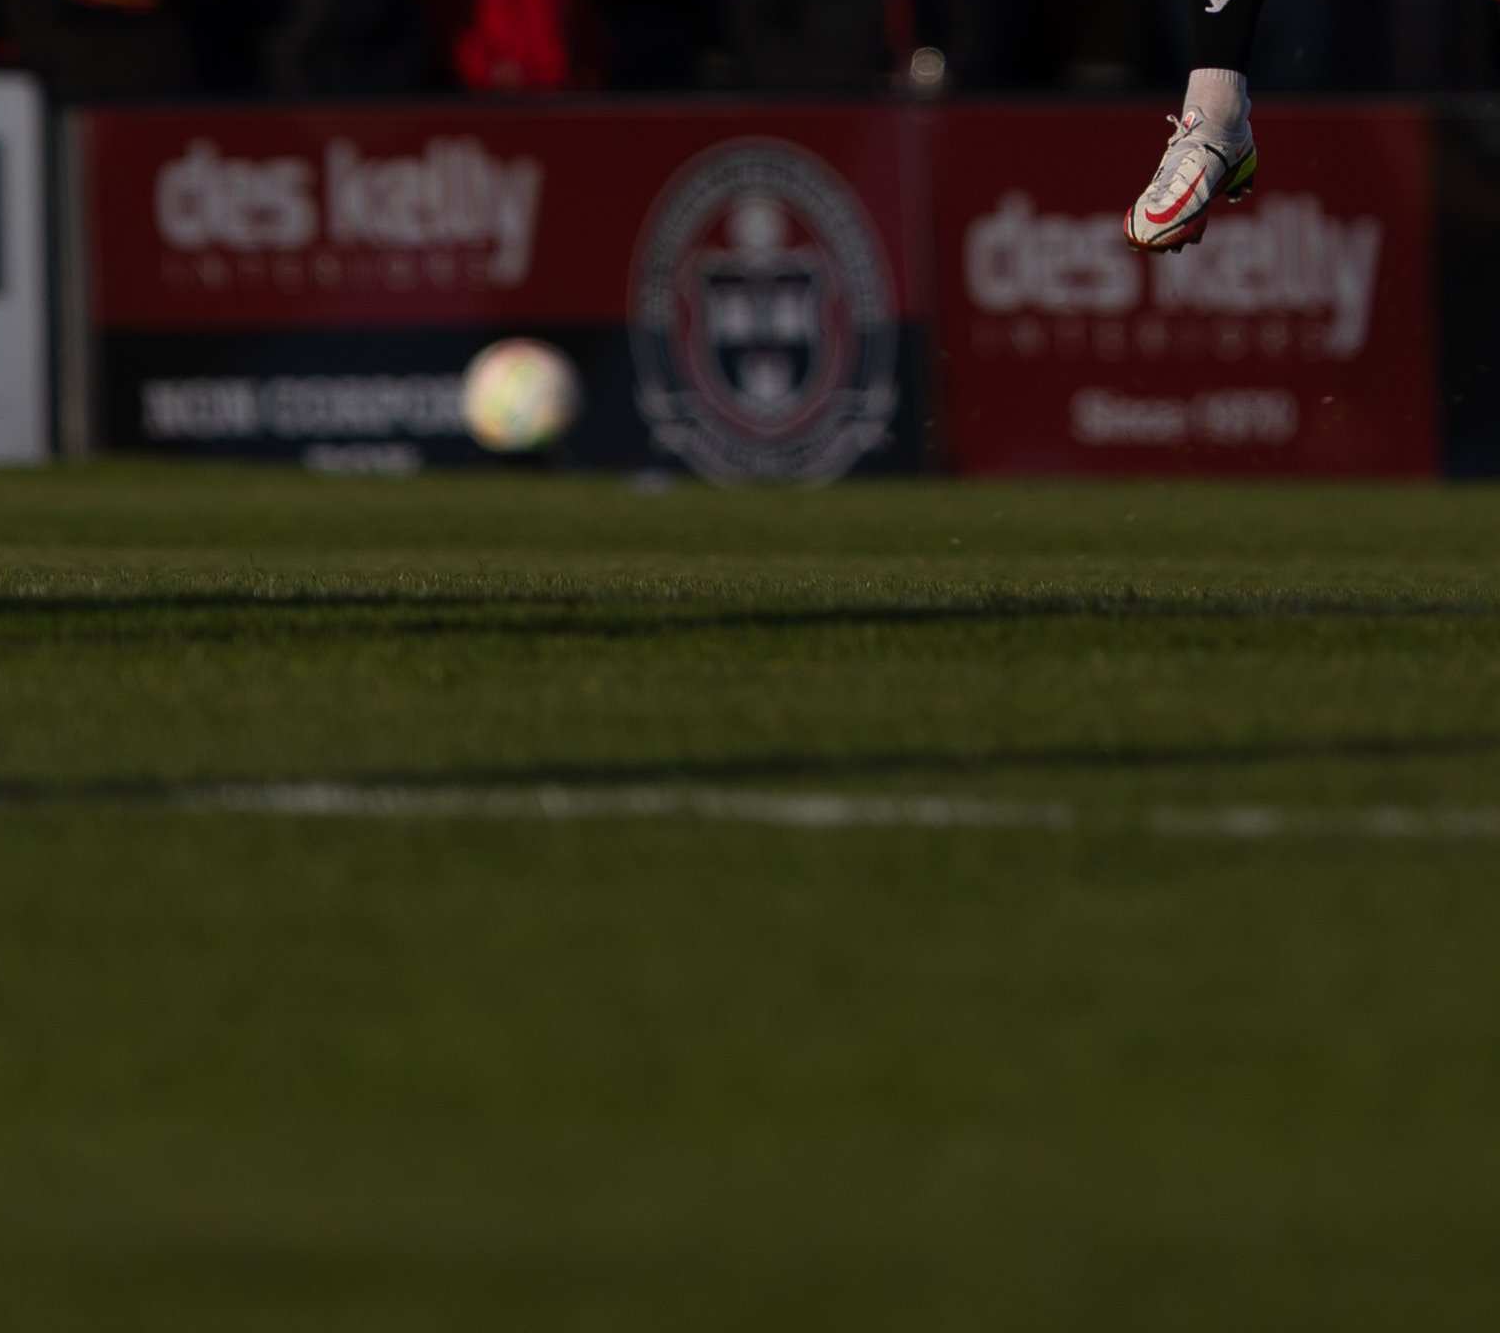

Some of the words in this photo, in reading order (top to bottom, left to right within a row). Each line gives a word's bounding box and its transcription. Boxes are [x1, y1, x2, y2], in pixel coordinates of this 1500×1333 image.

[153, 137, 318, 251] des
[323, 133, 544, 290] kelly
[963, 189, 1145, 316] des
